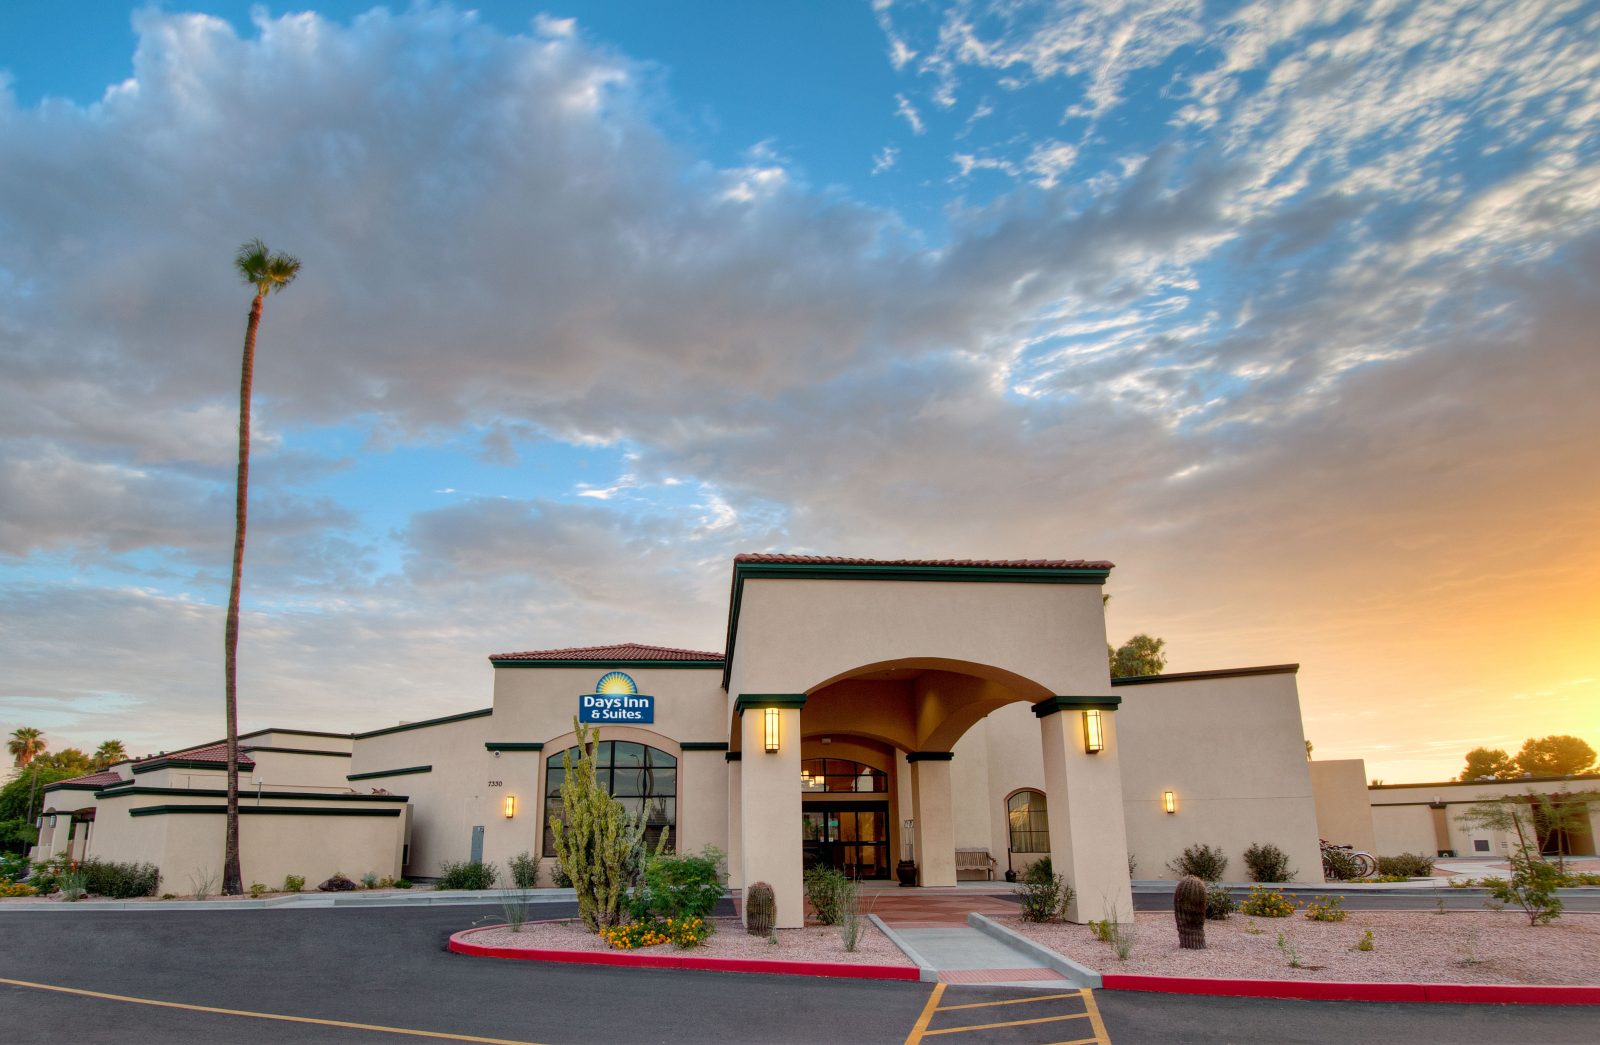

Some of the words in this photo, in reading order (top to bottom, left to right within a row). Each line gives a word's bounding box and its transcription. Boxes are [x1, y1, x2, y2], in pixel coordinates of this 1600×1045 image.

[584, 696, 621, 709] Days
[624, 696, 649, 708] Inn
[591, 709, 600, 719] &
[603, 709, 642, 719] Suites
